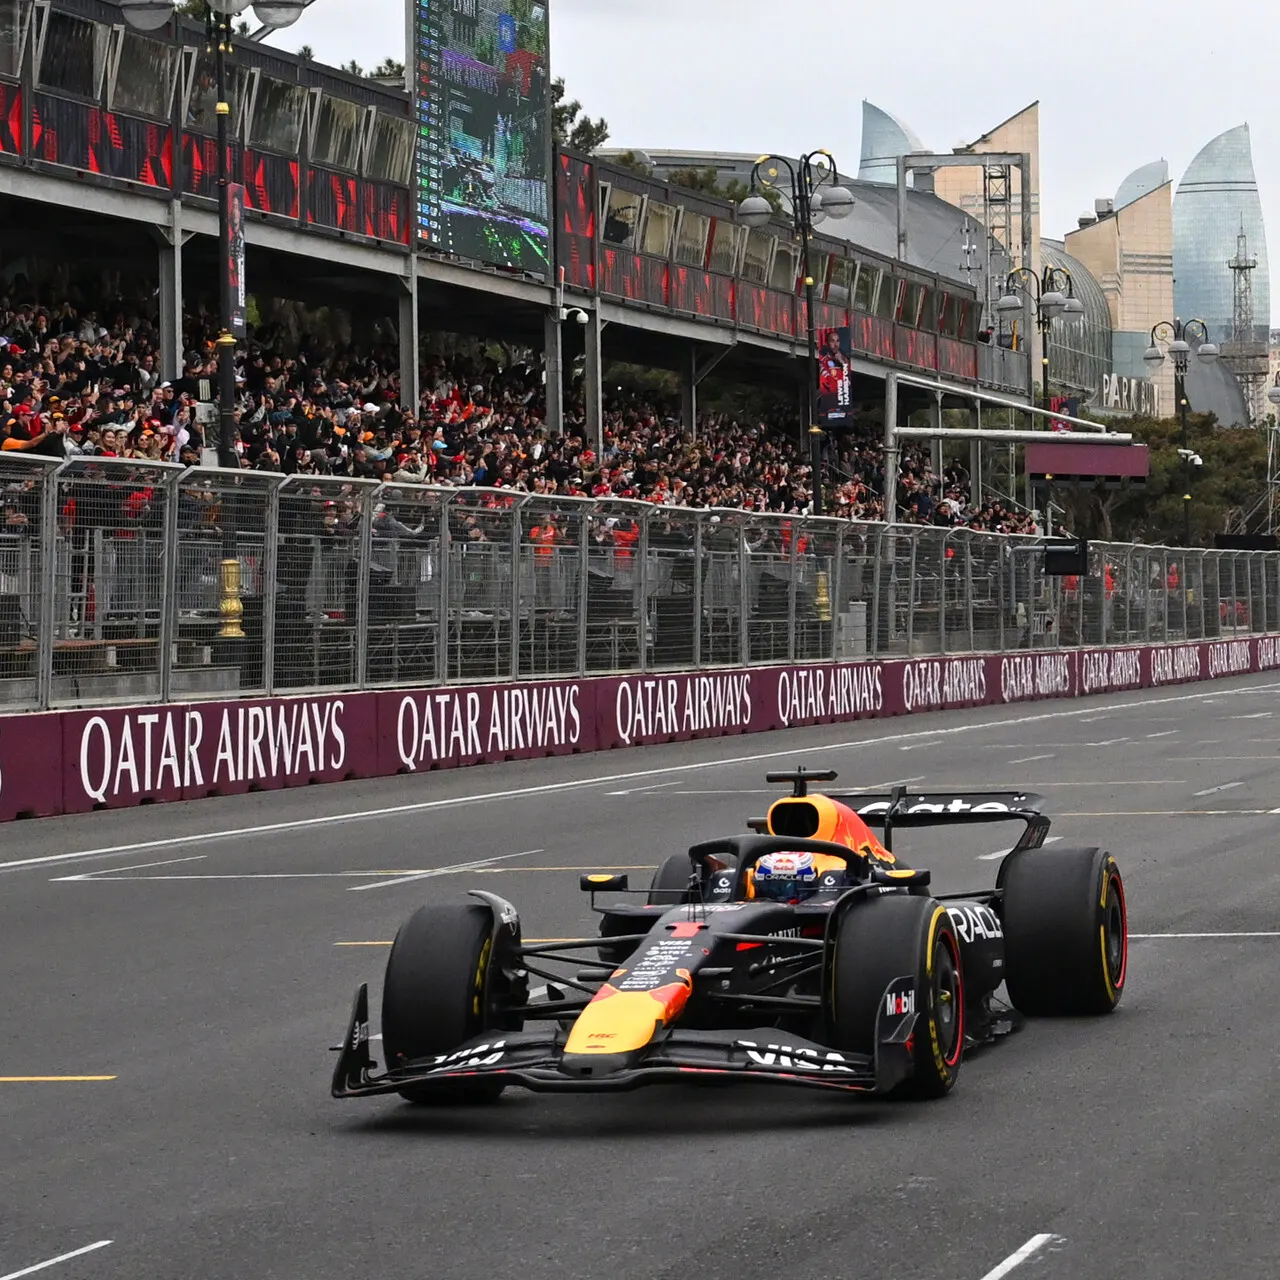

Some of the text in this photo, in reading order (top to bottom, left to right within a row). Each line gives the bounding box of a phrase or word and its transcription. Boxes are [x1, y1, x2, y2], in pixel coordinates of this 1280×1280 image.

[1103, 373, 1137, 411] PARK
[777, 665, 883, 725] QATAR AIRWAYS
[902, 659, 986, 711] QATAR AIRWAYS
[1001, 656, 1033, 703] QATAR
[397, 685, 580, 770] QATAR AIRWAYS
[616, 674, 751, 744] QATAR AIRWAYS
[80, 694, 346, 803] QATAR AIRWAYS
[886, 990, 915, 1016] Mobil
[736, 1040, 855, 1072] VISA
